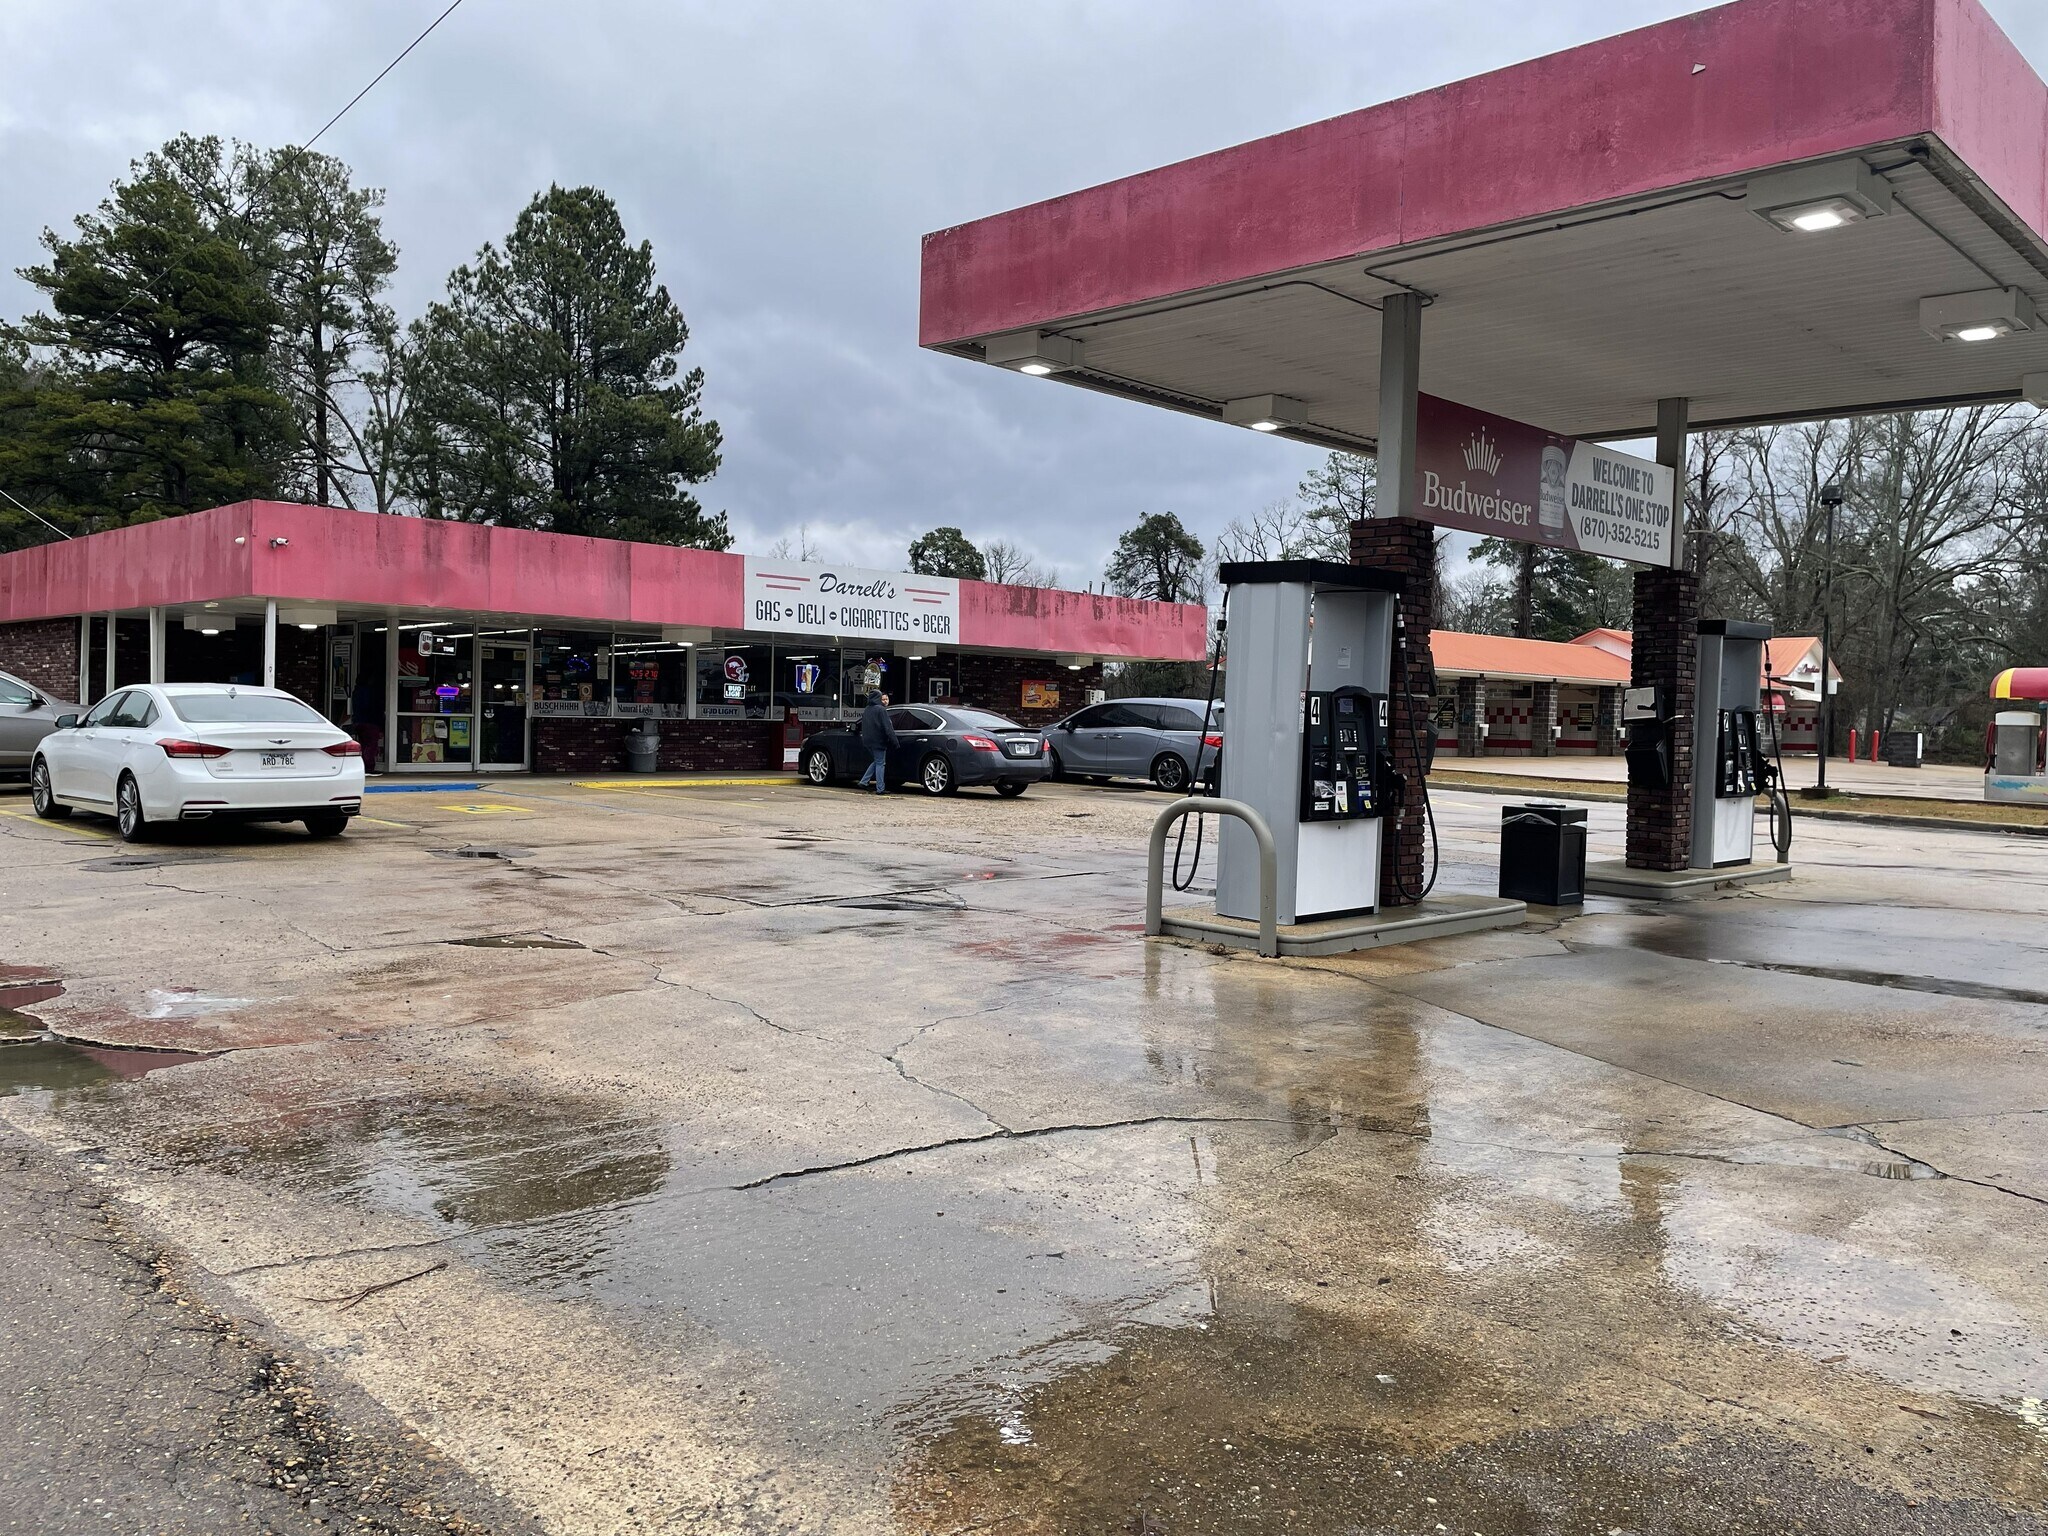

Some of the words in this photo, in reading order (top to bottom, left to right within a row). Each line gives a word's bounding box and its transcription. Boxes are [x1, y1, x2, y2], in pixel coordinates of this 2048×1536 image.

[1593, 457, 1640, 492] WELCOME
[1642, 471, 1654, 496] TO
[1423, 471, 1532, 526] Budweiser
[1571, 482, 1623, 518] DARRELL'S
[1625, 496, 1644, 523] ONE
[1645, 502, 1670, 528] STOP
[1580, 516, 1660, 550] (870)-352-5215
[819, 572, 897, 599] Darrell's
[756, 599, 781, 621] GAS
[798, 603, 826, 625] DELI
[841, 606, 909, 631] CIGARETTES
[923, 614, 951, 635] BEER
[1312, 698, 1319, 724] 4
[1380, 702, 1387, 726] 4
